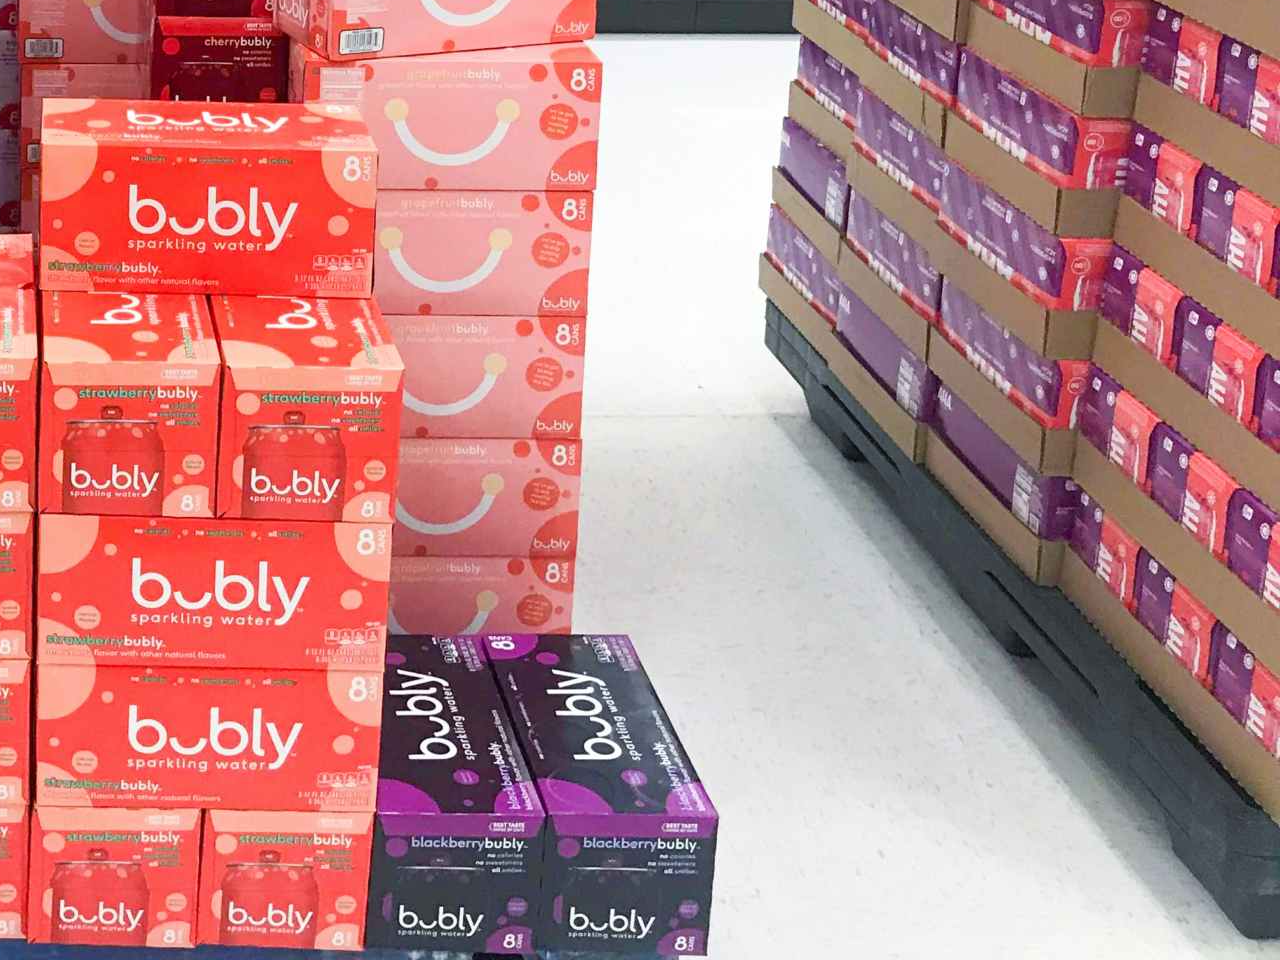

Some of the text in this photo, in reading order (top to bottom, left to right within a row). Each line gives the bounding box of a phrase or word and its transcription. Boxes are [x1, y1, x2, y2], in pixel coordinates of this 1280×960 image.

[554, 21, 590, 34] bubly
[570, 69, 587, 91] 8
[587, 69, 596, 91] CANS
[127, 109, 289, 132] bubly
[343, 155, 362, 182] 8
[551, 170, 590, 184] bubly
[128, 184, 298, 251] bubly
[562, 199, 578, 221] 8
[578, 199, 587, 221] CANS
[127, 238, 265, 253] sparkling water
[542, 295, 580, 312] bubly
[70, 462, 160, 497] bubly
[250, 468, 341, 504] bubly
[357, 528, 376, 556] 8
[131, 557, 311, 626] bubly
[130, 612, 273, 628] sparkling water
[389, 668, 458, 761] bubly
[546, 668, 623, 761] bubly
[128, 704, 304, 770] bubly
[59, 900, 145, 931] bubly
[227, 903, 314, 935] bubly
[398, 904, 484, 936] bubly
[569, 906, 656, 939] bubly
[504, 933, 516, 948] 8
[674, 936, 687, 951] 8
